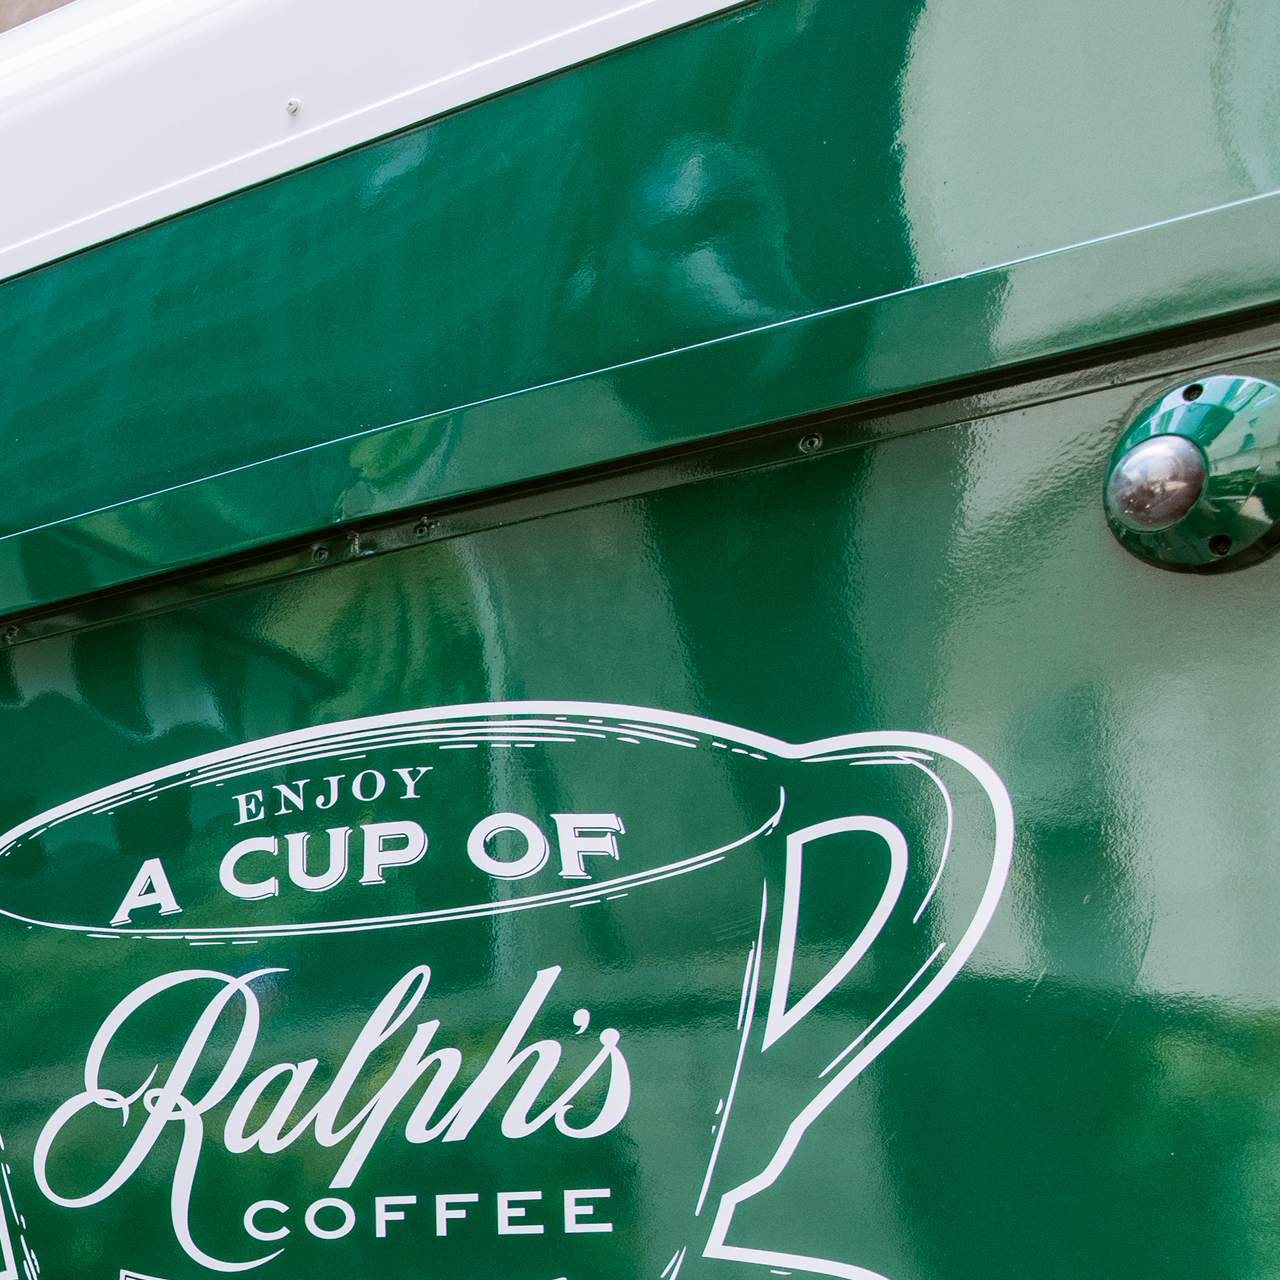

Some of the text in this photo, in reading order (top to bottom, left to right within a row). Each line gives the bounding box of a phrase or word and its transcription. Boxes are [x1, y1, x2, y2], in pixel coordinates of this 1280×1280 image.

[231, 766, 434, 827] ENJOY
[109, 811, 628, 927] A CUP OF
[32, 964, 632, 1273] Ralph's
[242, 1187, 614, 1242] COFFEE
